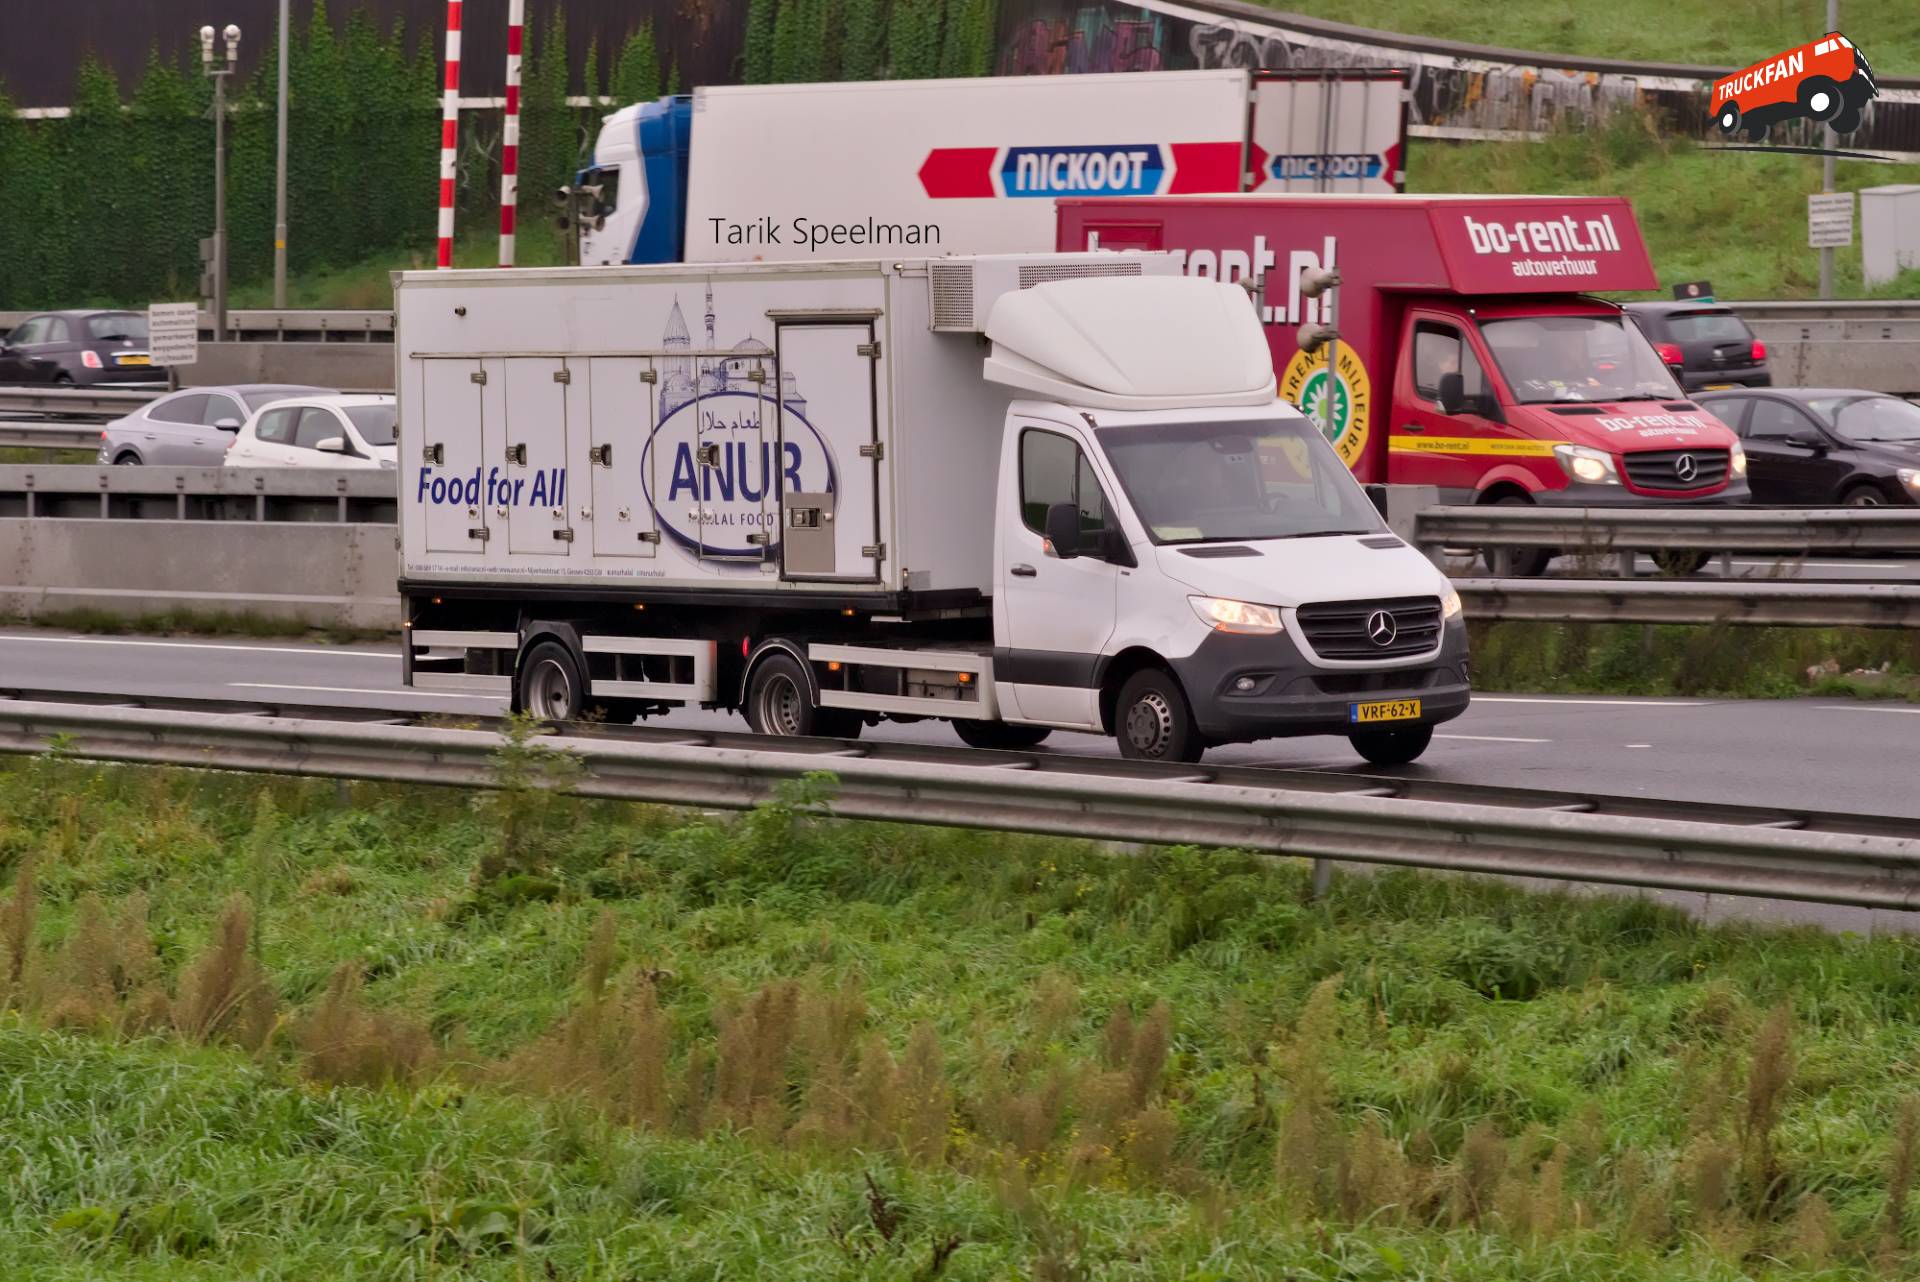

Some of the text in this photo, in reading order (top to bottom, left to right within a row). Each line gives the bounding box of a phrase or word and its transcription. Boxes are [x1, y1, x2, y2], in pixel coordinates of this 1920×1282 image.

[1463, 214, 1621, 254] bo-rent.nl
[1511, 255, 1598, 277] autoverhuur
[1594, 414, 1708, 432] bo-rent.nl
[417, 466, 566, 507] Food for All
[668, 441, 803, 502] ANUR
[1361, 702, 1417, 719] VRF-62-X
